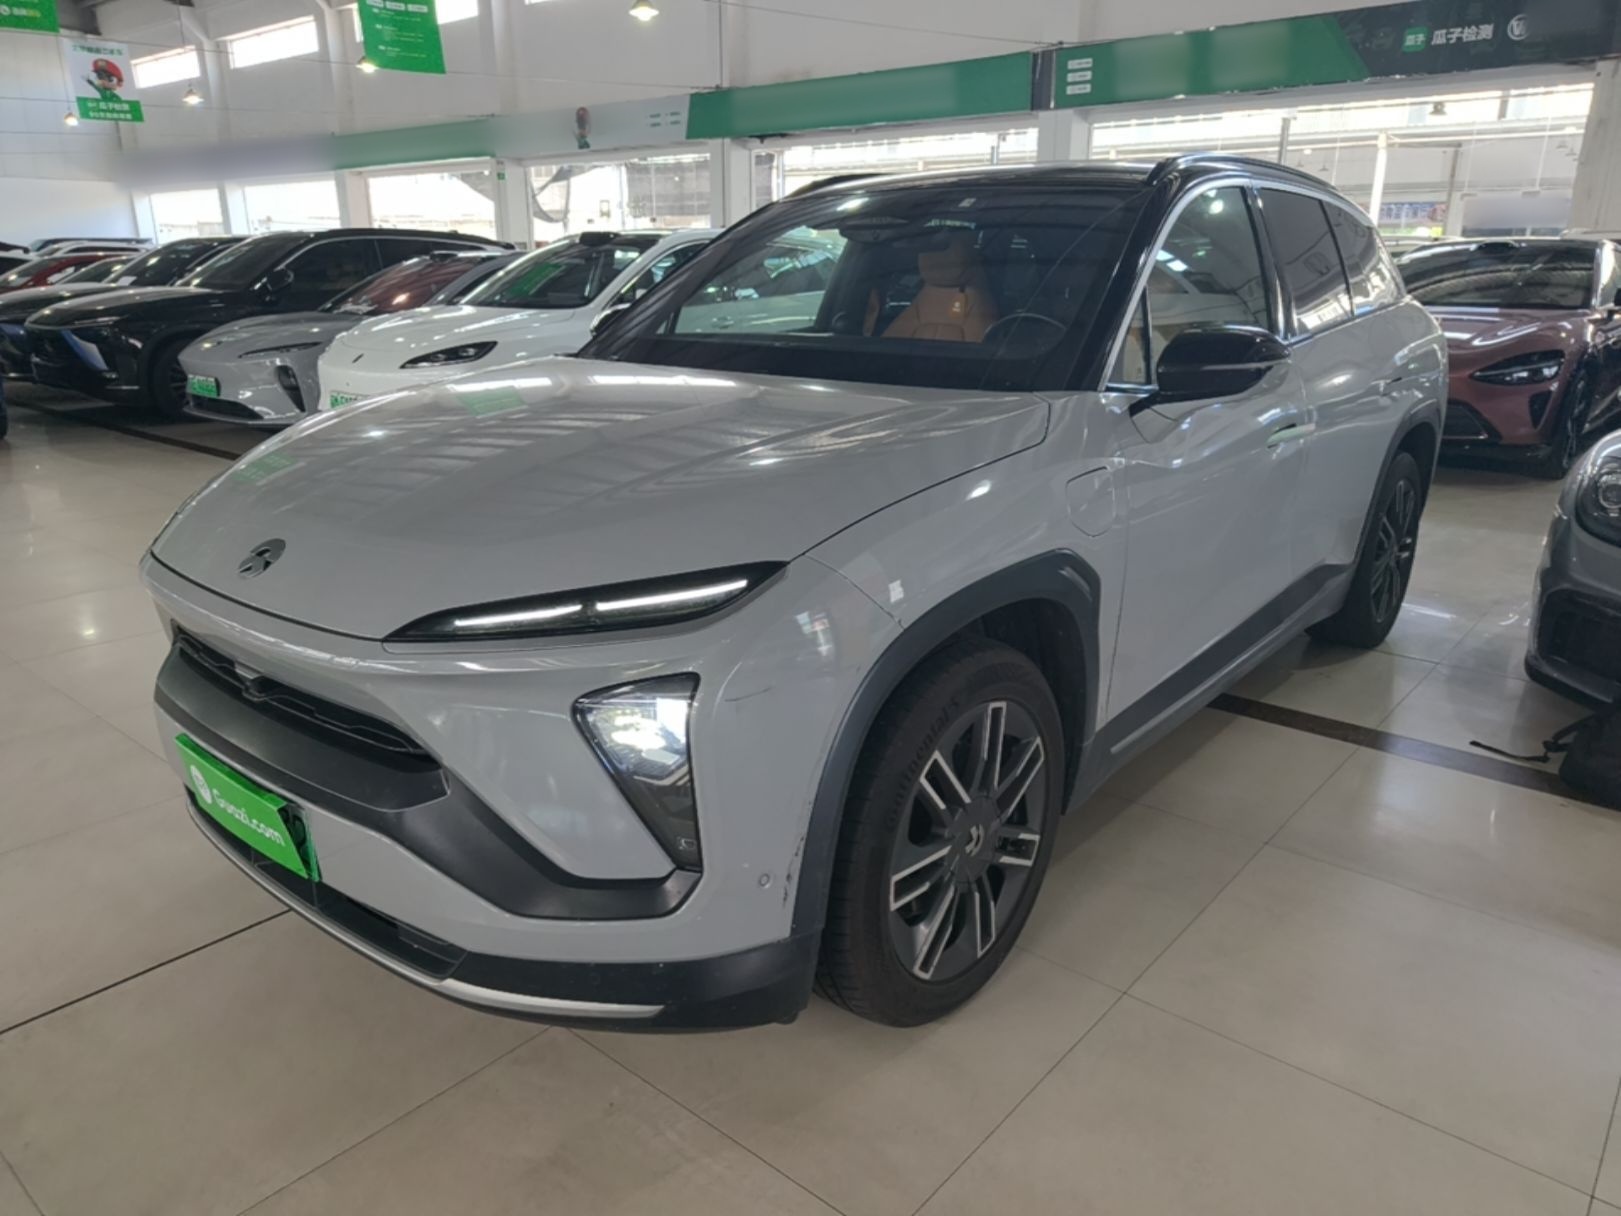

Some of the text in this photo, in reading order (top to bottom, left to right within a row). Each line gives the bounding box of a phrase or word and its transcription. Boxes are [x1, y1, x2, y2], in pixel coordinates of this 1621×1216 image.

[1404, 33, 1426, 46] 瓜子
[1431, 23, 1495, 46] 瓜子检测
